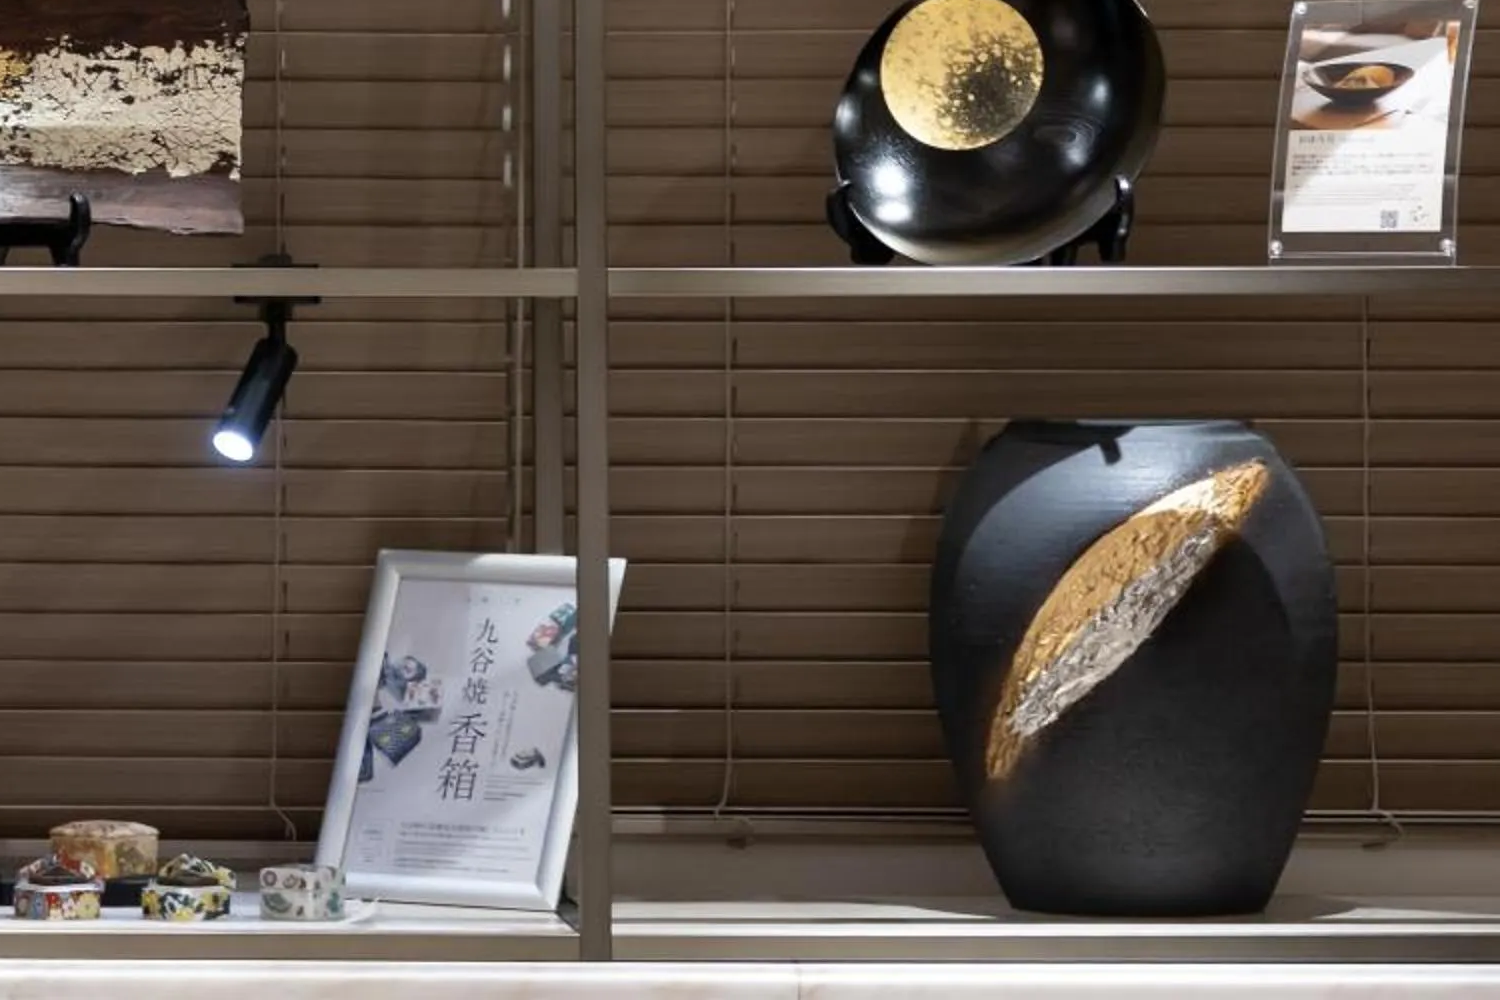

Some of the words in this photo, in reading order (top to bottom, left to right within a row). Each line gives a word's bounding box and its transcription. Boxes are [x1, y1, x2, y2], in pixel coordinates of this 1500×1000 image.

[436, 617, 499, 801] 九谷焼香箱
